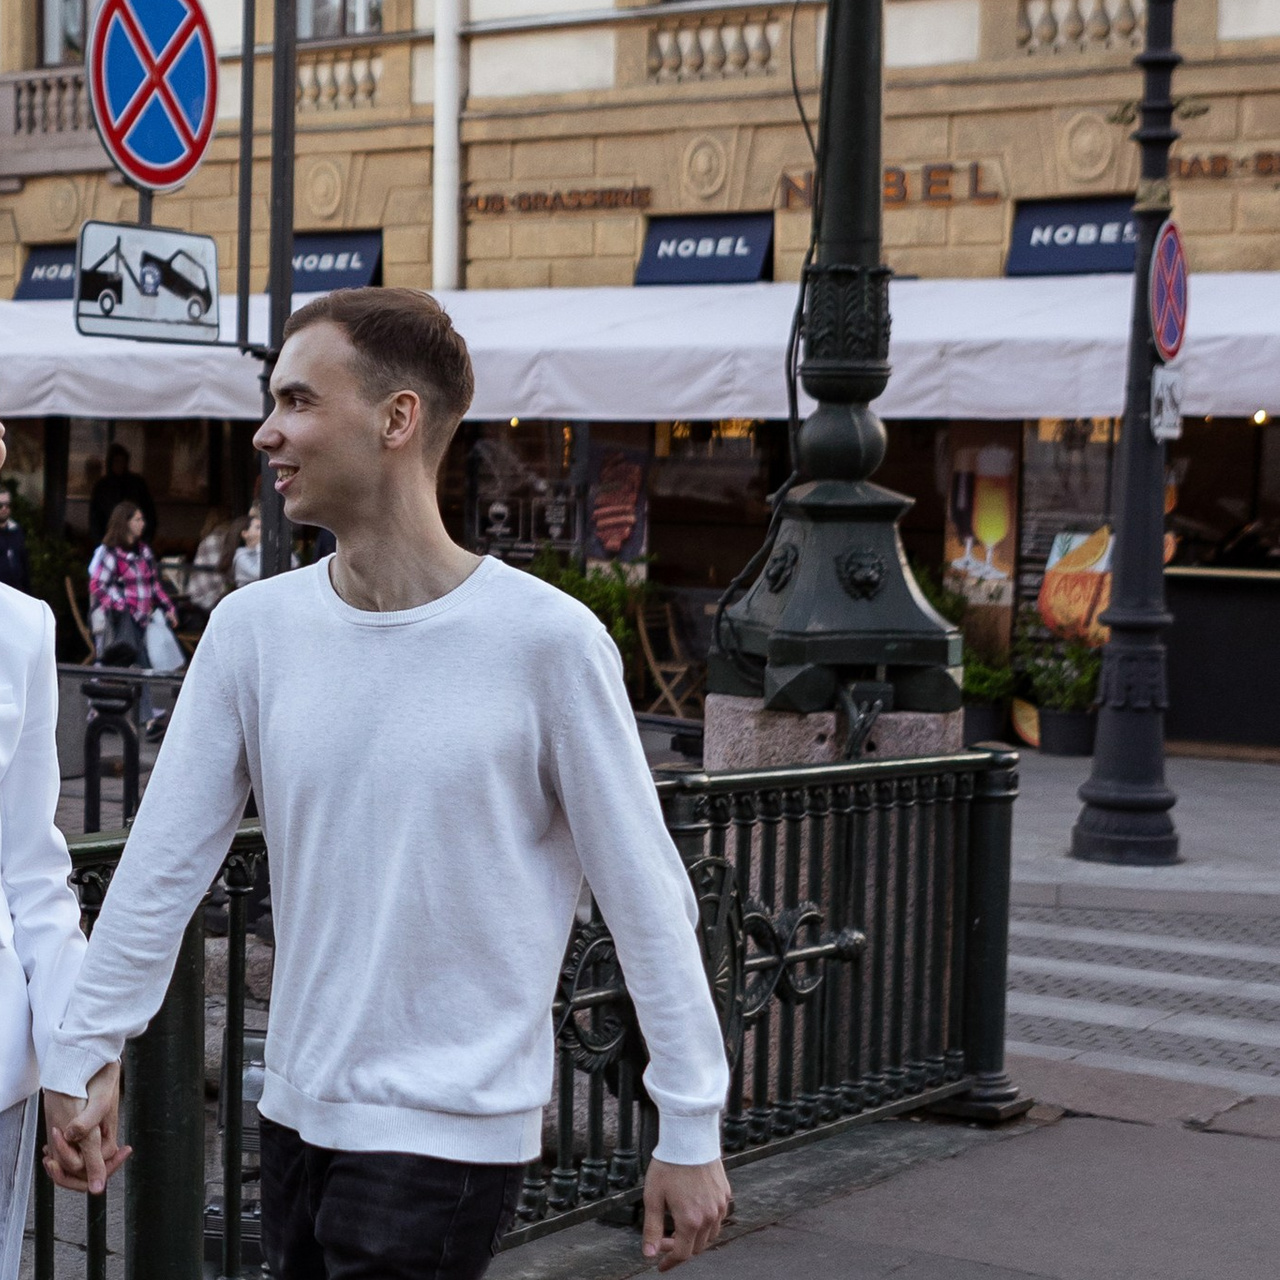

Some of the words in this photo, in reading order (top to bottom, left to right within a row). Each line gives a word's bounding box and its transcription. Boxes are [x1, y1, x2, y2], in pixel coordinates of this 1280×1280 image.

[781, 161, 1001, 209] NBEL
[657, 236, 751, 258] NOBEL
[31, 264, 77, 280] NOB
